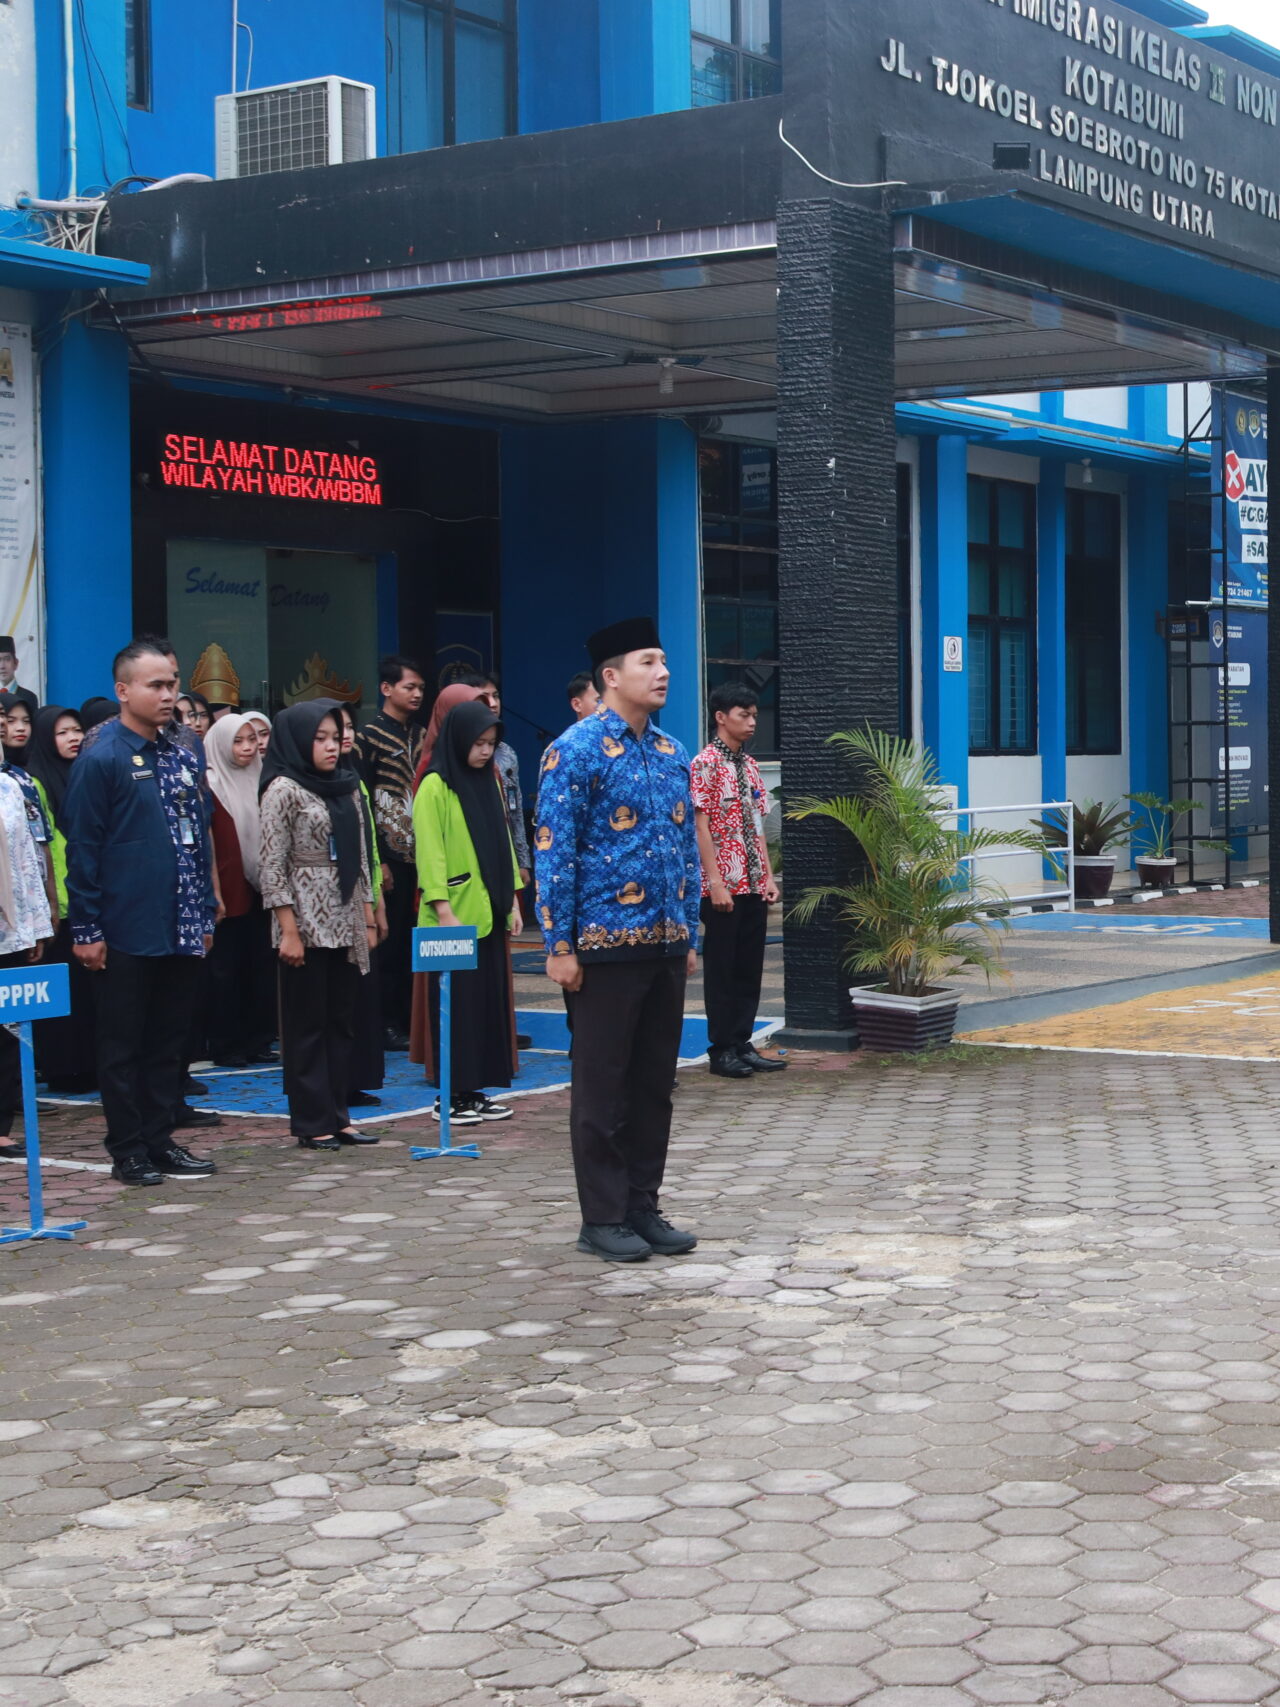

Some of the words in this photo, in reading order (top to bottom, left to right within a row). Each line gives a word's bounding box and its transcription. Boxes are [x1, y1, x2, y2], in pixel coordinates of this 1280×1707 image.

[1065, 56, 1184, 140] KOTABUMI
[1130, 26, 1201, 92] KELAS
[1237, 73, 1277, 126] NON
[881, 38, 922, 83] JL.
[932, 56, 1043, 130] TJOKOEL
[1050, 104, 1163, 177] SOEBROTO
[1169, 152, 1197, 189] NO
[1204, 166, 1225, 200] 75
[1040, 149, 1144, 215] LAMPUNG
[1152, 190, 1215, 240] UTARA
[165, 433, 279, 471] SELAMAT
[284, 447, 377, 482] DATANG
[1245, 463, 1268, 492] AY
[160, 461, 263, 494] WILAYAH
[266, 472, 383, 506] WBK/WBBM
[185, 567, 261, 599] Selamat
[269, 584, 331, 613] Datang
[420, 939, 474, 957] OUTSOURCHING
[0, 981, 50, 1008] PPPK
